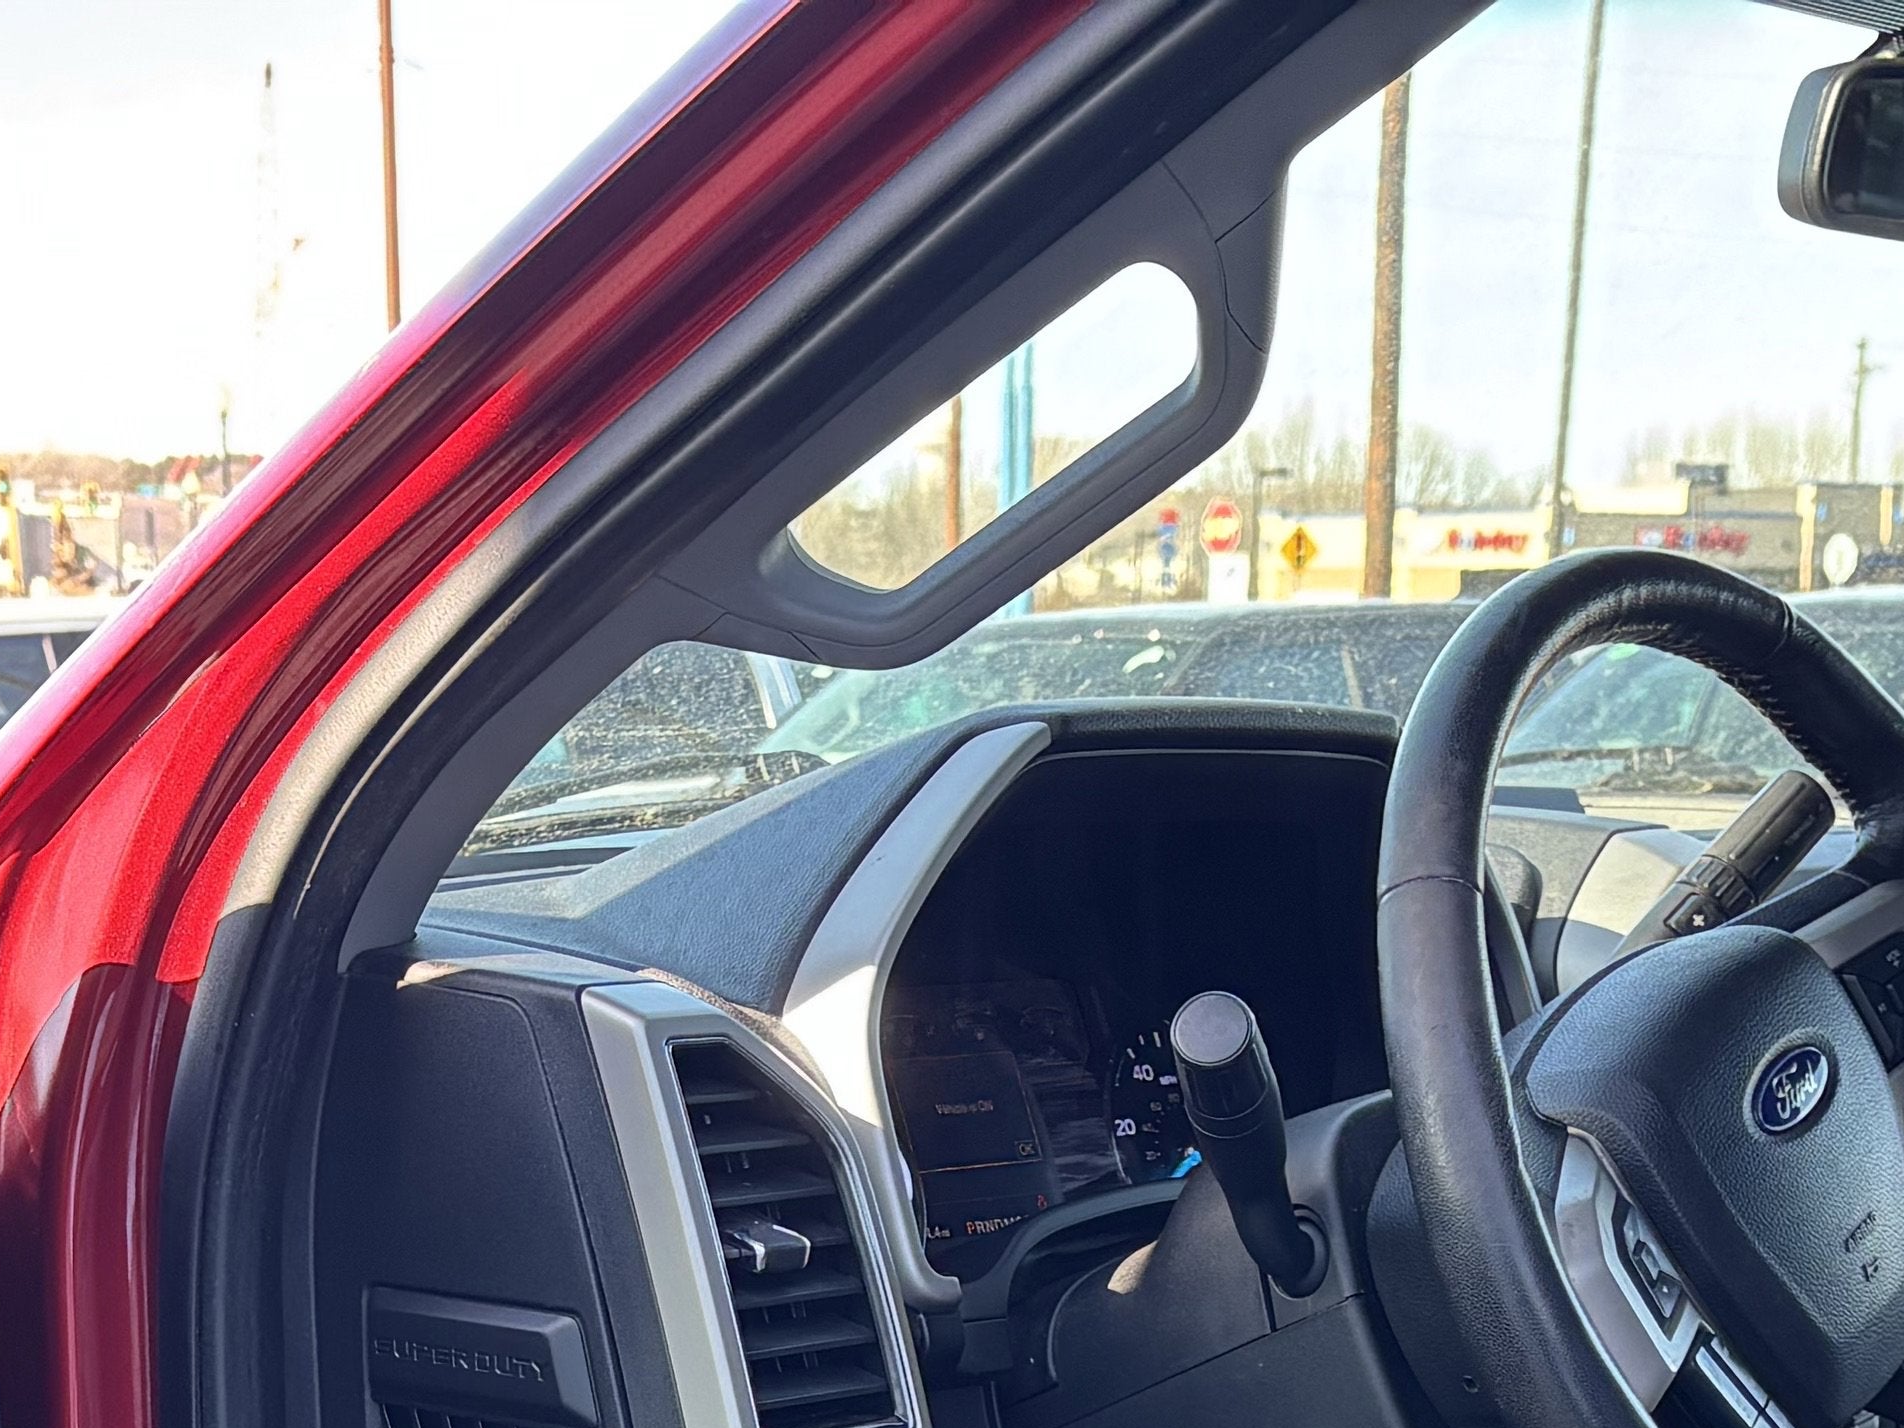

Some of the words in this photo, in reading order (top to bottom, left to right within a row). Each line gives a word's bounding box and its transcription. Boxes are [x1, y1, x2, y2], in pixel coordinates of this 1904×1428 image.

[1133, 1063, 1155, 1082] 40
[1772, 1059, 1818, 1119] Ford
[1114, 1118, 1137, 1137] 20
[374, 1338, 469, 1369] SUPER
[474, 1351, 545, 1383] DUTY
